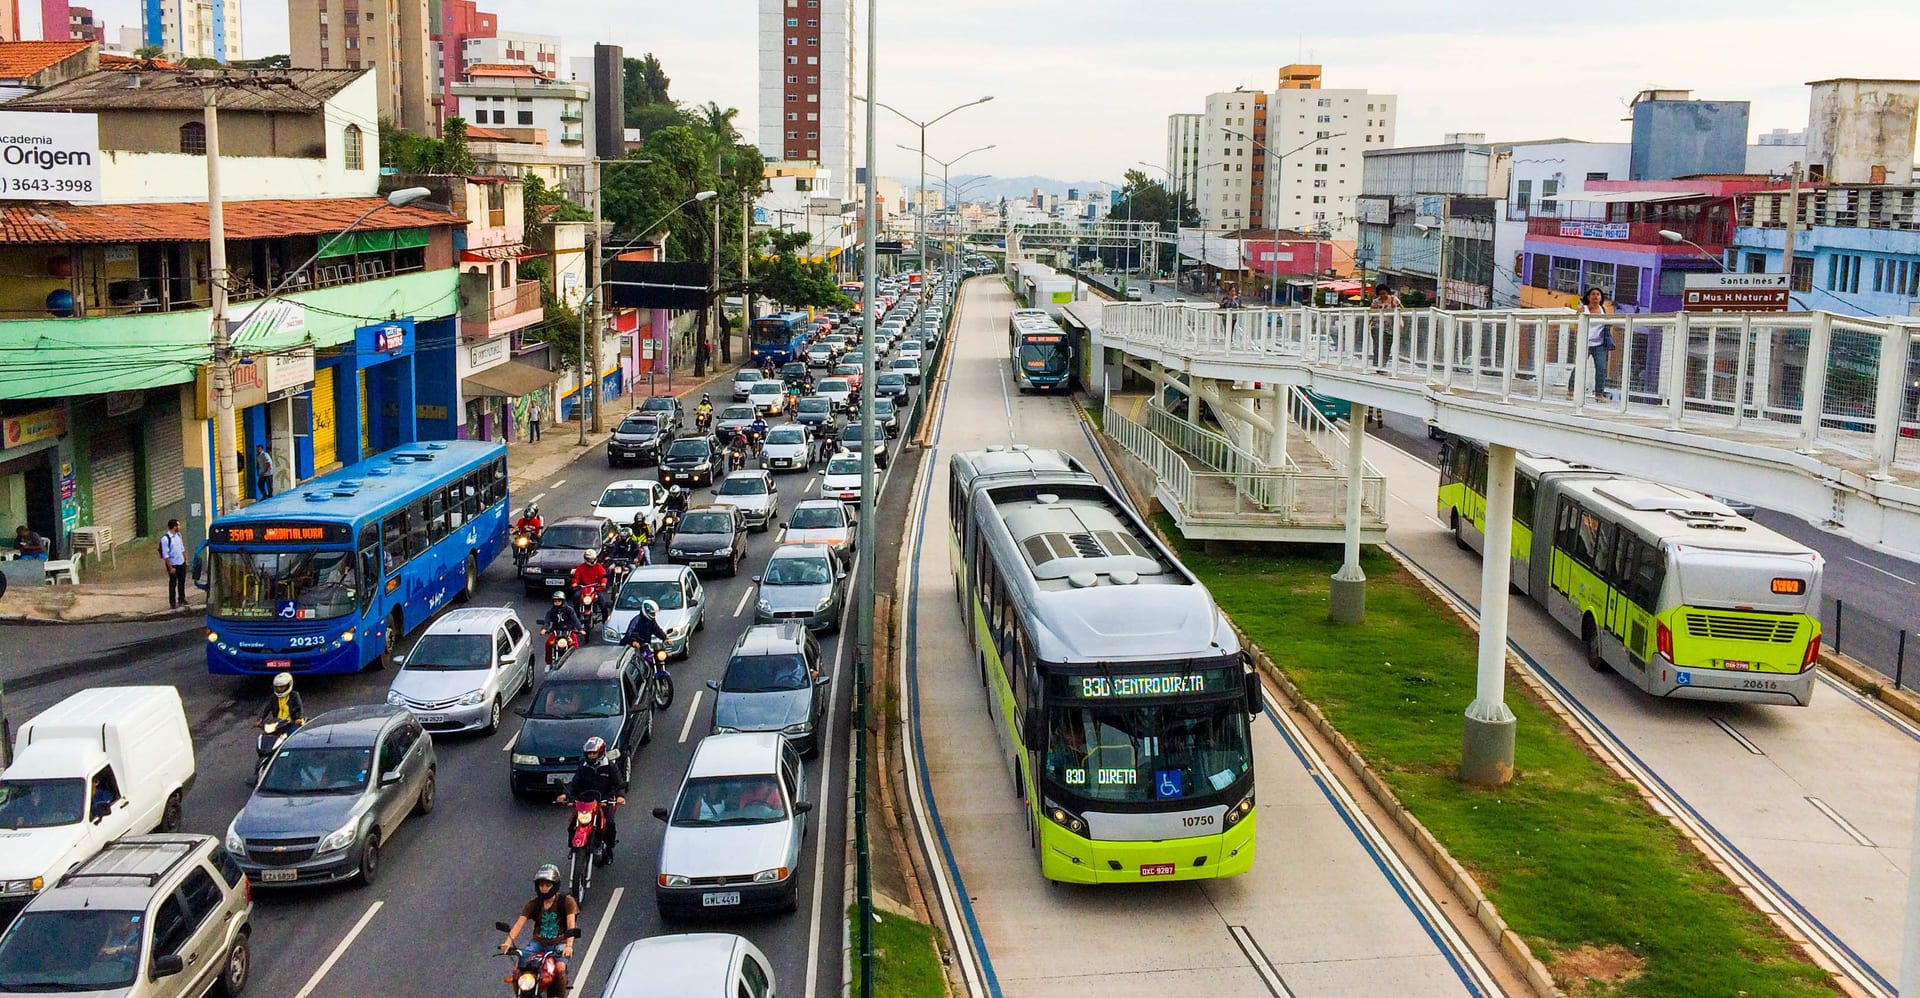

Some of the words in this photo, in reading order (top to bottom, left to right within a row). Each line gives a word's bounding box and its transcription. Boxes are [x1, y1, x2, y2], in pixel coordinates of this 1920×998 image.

[0, 135, 53, 145] cademia
[4, 145, 91, 170] Origem
[12, 178, 92, 192] 3643-3998
[1720, 277, 1749, 285] Santa
[1735, 293, 1772, 302] Natural
[290, 635, 326, 647] 20233
[1082, 677, 1110, 697] 83D
[1113, 677, 1161, 695] CENTRO
[1161, 675, 1204, 693] DIRETA
[1743, 680, 1777, 690] 20616
[1065, 768, 1085, 784] 83D
[1098, 768, 1137, 784] DIRETA
[1182, 815, 1214, 827] 10750
